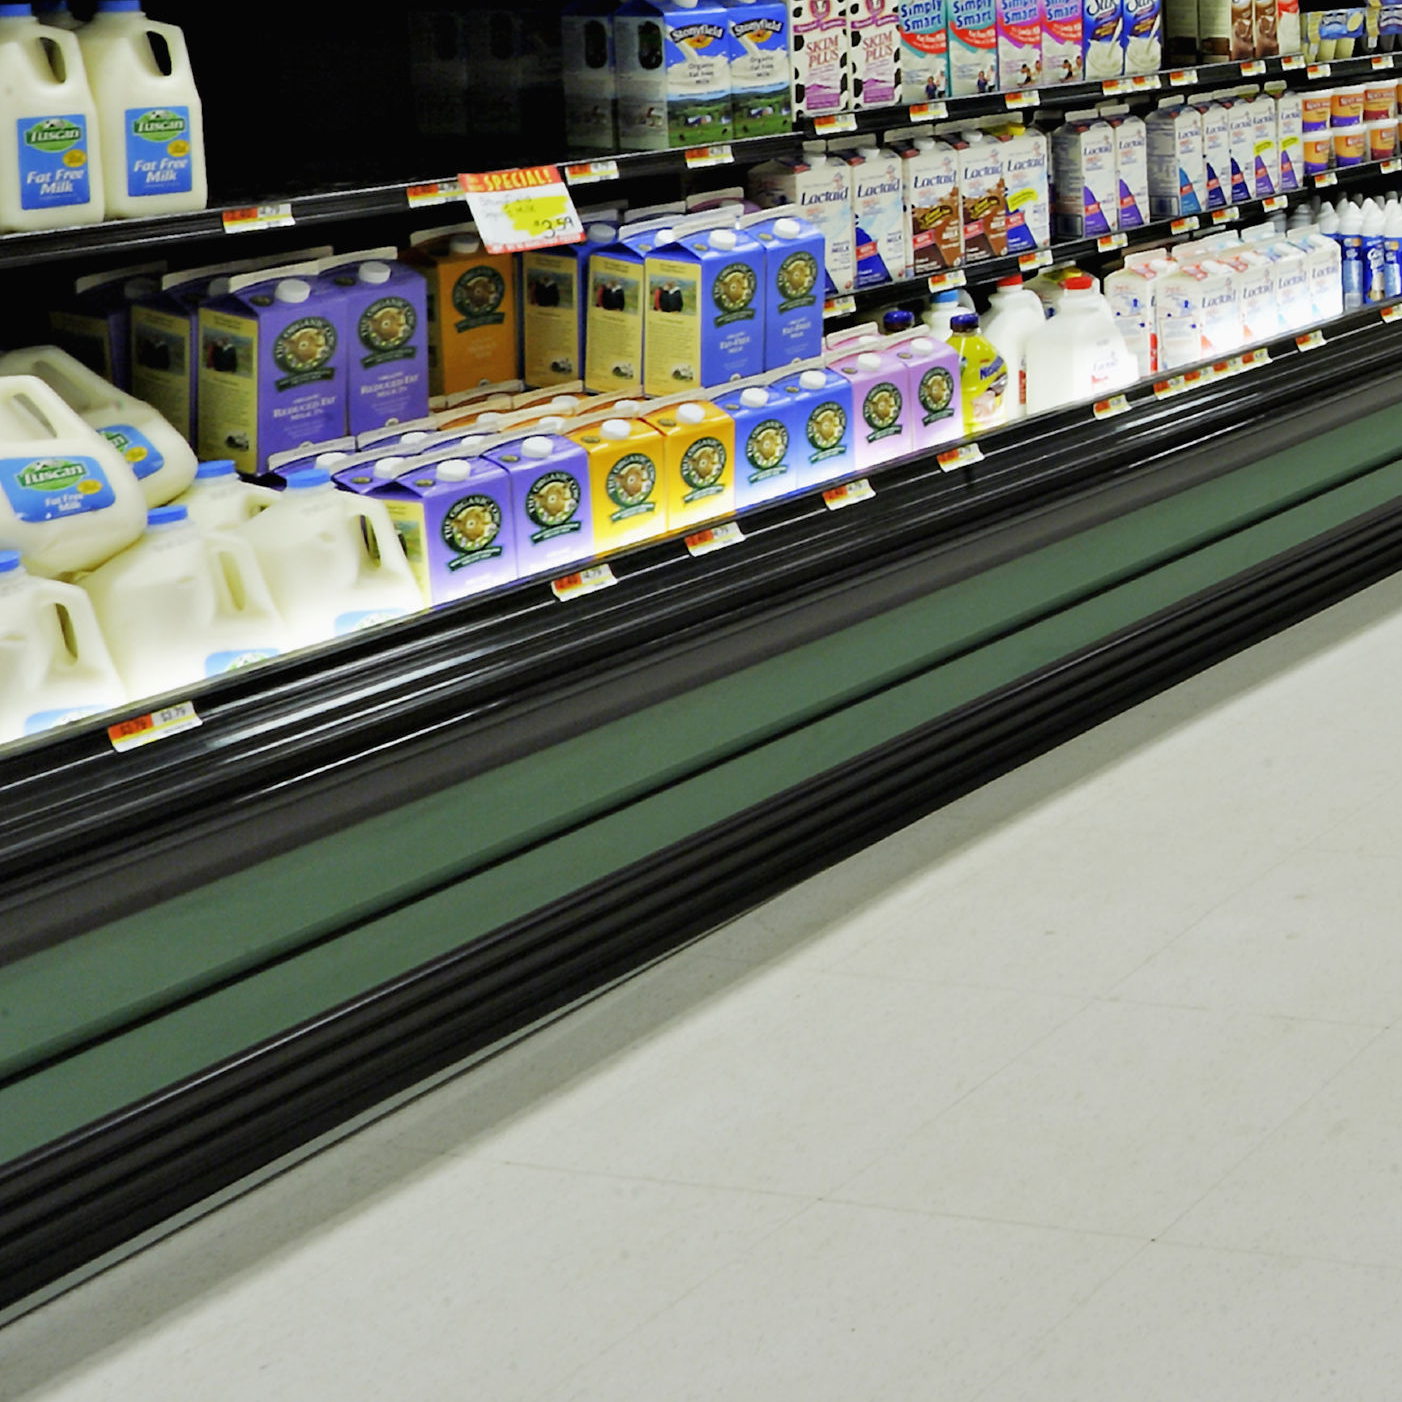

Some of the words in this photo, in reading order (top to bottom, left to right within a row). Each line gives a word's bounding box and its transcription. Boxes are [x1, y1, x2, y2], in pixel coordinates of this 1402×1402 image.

[955, 9, 993, 29] Smart
[1004, 7, 1038, 25] Smart
[1047, 3, 1080, 22] Smart
[734, 20, 783, 36] Stonyfield
[903, 13, 942, 32] Smart
[672, 25, 723, 42] Stonyfield
[863, 30, 893, 51] SKIM
[806, 35, 839, 55] SKIM
[865, 45, 894, 63] PLUS
[808, 50, 839, 68] PLUS
[138, 120, 184, 133] Tuscan
[30, 130, 80, 142] Tuscan
[134, 159, 157, 172] Fat
[160, 158, 188, 170] Free
[964, 163, 1004, 180] Lactaid
[1007, 154, 1045, 172] Lactaid
[27, 170, 51, 184] Fat
[55, 169, 84, 181] Free
[146, 169, 176, 183] Milk
[485, 169, 553, 191] SPECIAL!
[913, 170, 957, 190] Lactaid
[40, 180, 73, 195] Milk
[801, 186, 848, 206] Lactaid
[857, 180, 900, 199] Lactaid
[1201, 290, 1236, 308] Lactaid
[1243, 283, 1274, 300] Lactaid
[25, 465, 83, 485] Tuscan
